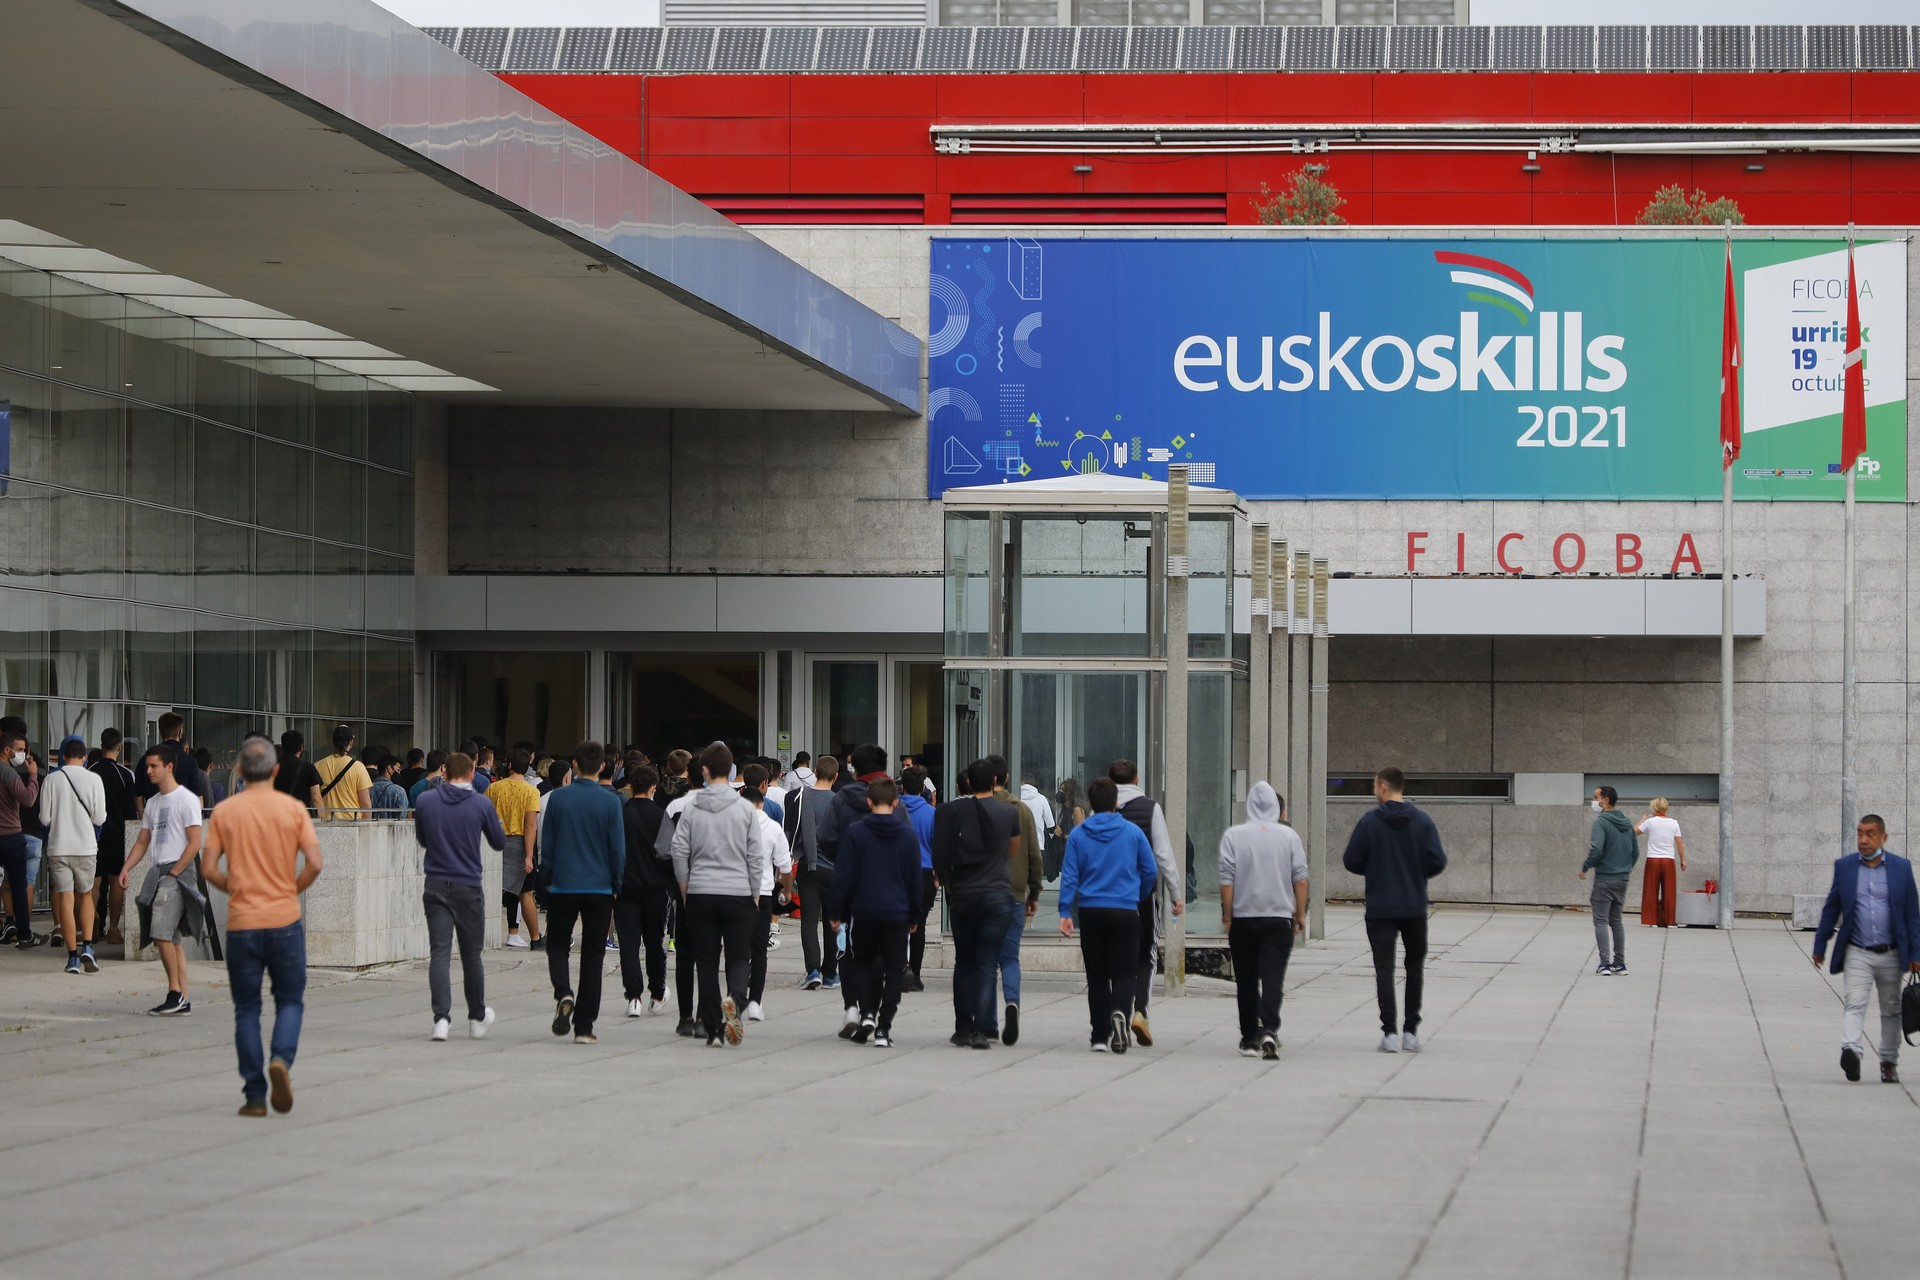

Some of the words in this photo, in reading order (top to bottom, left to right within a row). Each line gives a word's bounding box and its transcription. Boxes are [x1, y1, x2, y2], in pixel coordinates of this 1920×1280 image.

[1173, 311, 1628, 392] euskoskills
[1792, 348, 1817, 370] 19
[1792, 373, 1870, 391] octube
[1516, 405, 1627, 448] 2021
[1858, 456, 1880, 475] Fp
[1407, 532, 1703, 574] FICOBA
